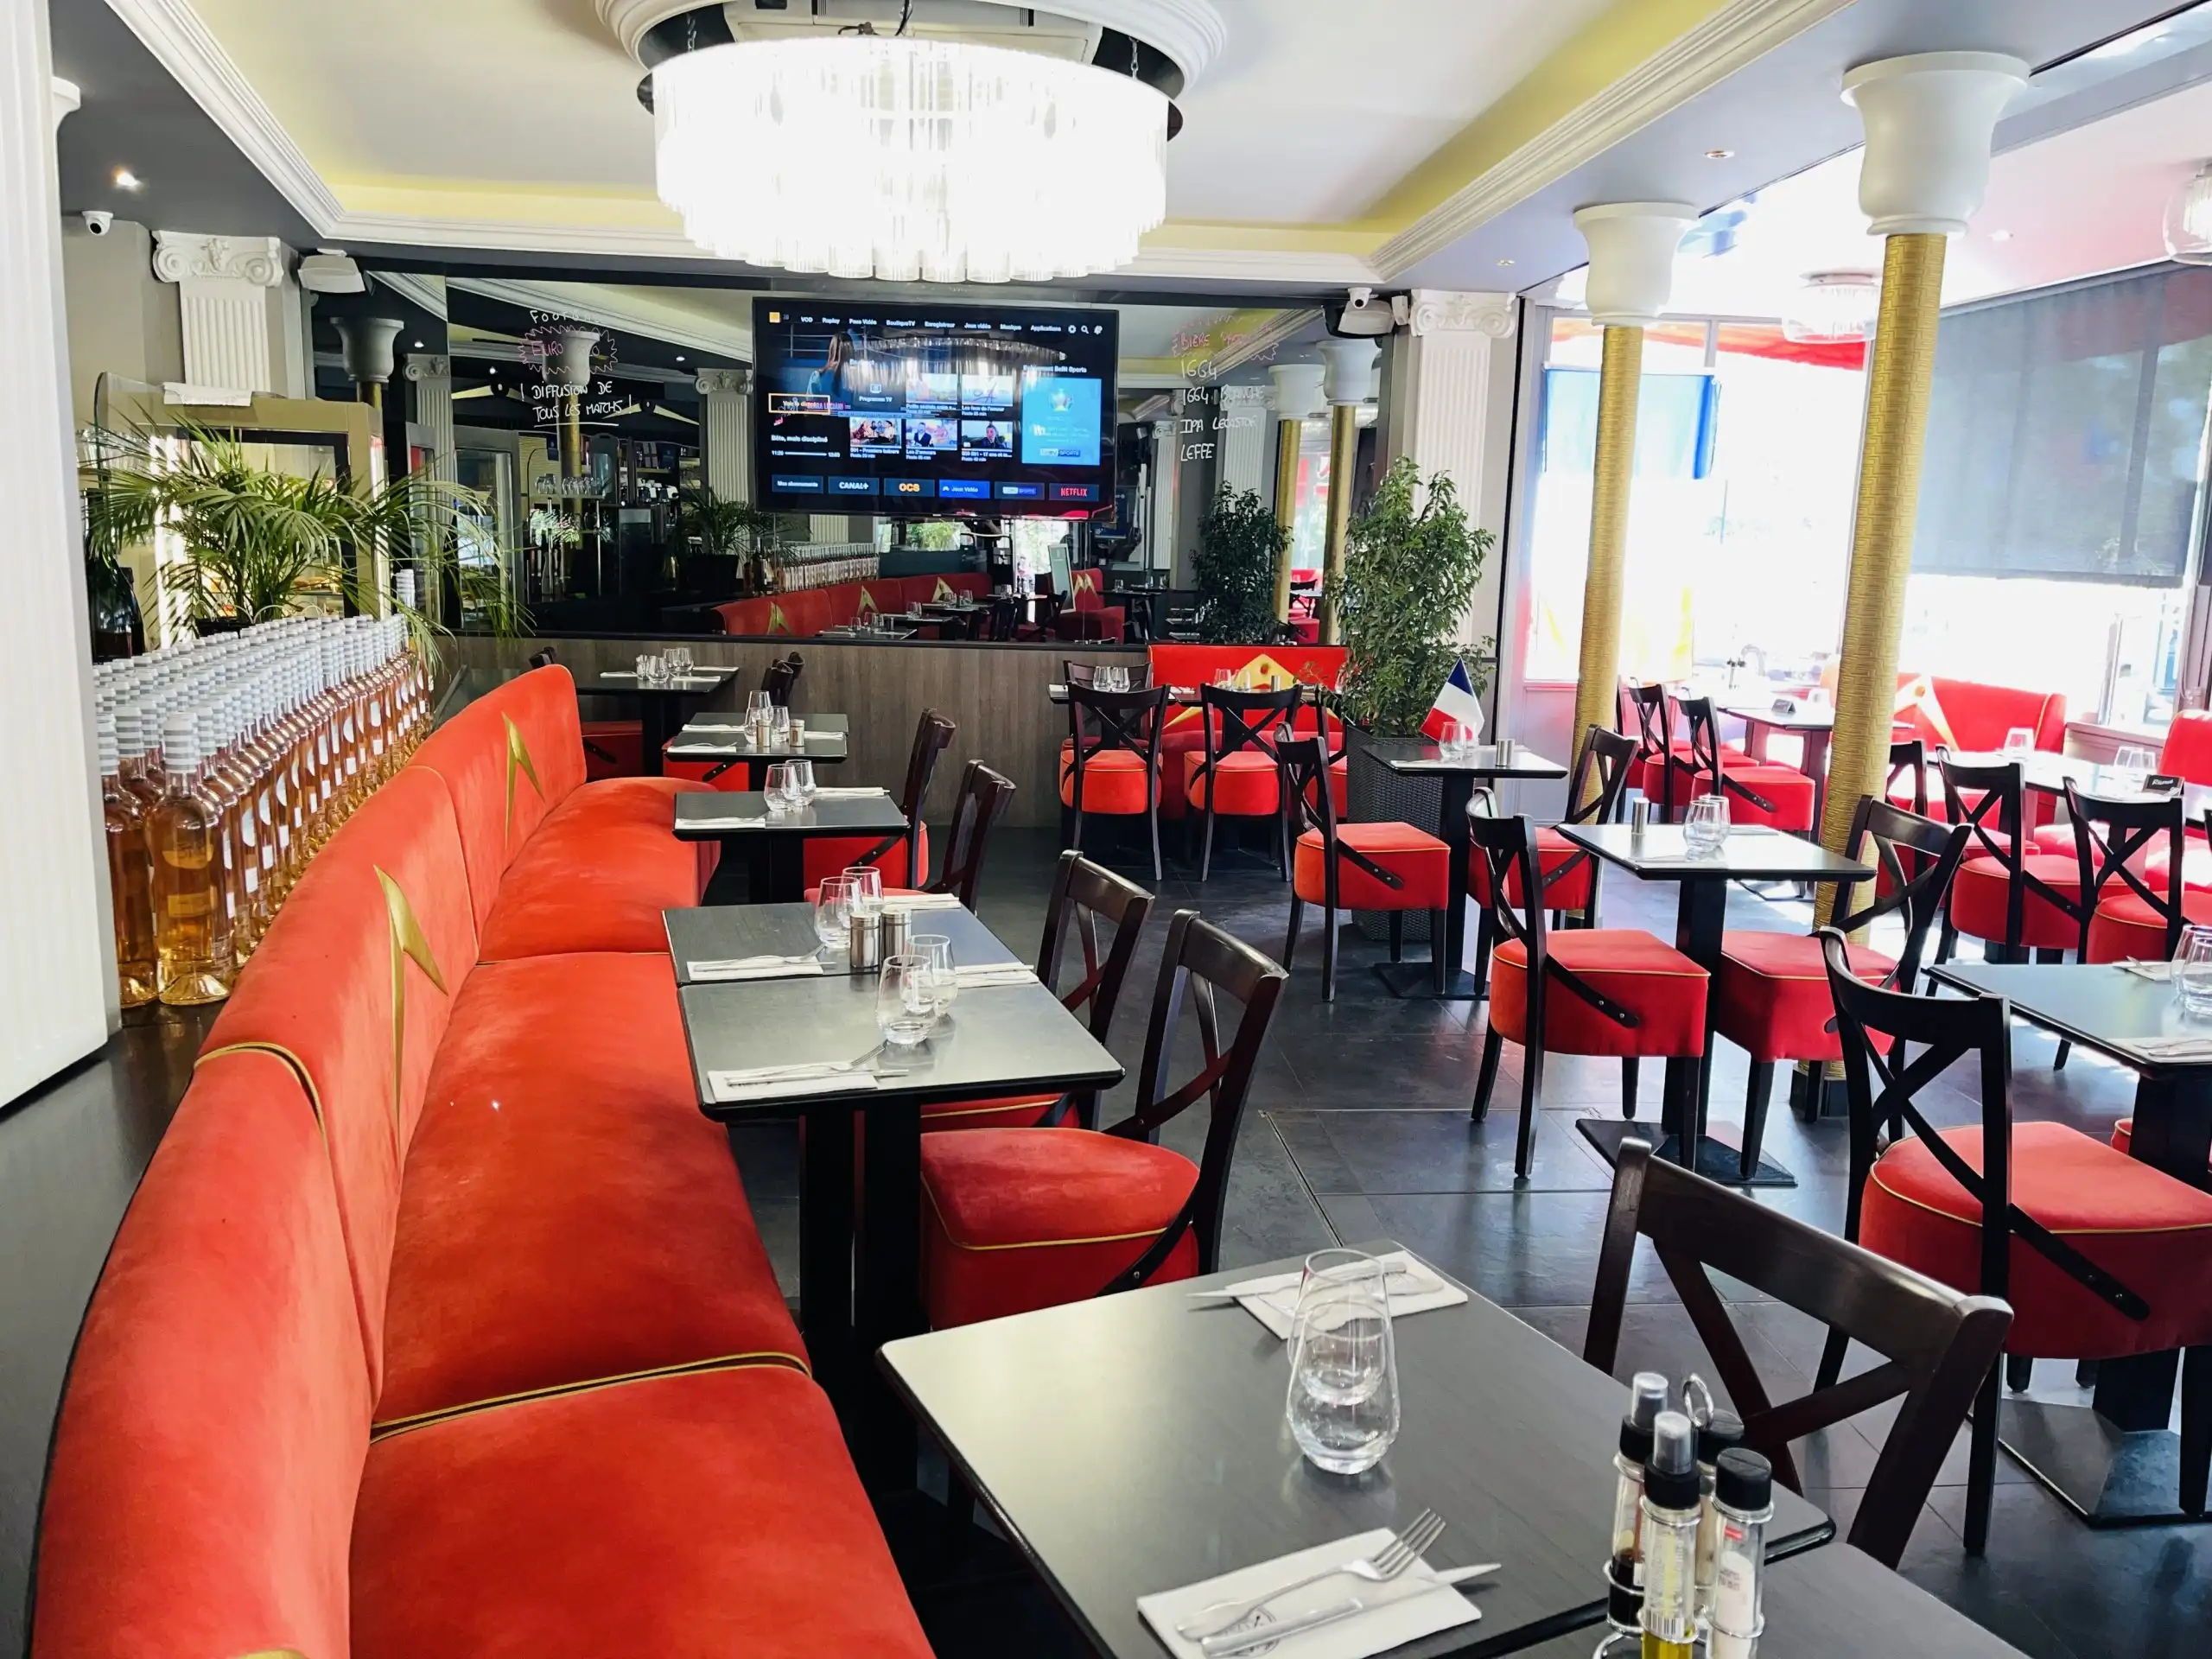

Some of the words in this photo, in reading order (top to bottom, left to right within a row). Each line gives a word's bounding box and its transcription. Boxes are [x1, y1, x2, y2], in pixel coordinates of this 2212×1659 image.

[531, 340, 563, 356] EURO
[1180, 359, 1217, 381] 1664
[597, 381, 613, 395] DE
[1182, 386, 1209, 406] 1664
[532, 404, 559, 423] TOUS
[565, 404, 581, 416] LES
[586, 400, 623, 415] MATCHS
[1179, 419, 1204, 434] IPA
[1180, 443, 1215, 462] LEFFE
[899, 483, 920, 492] OCS
[1060, 487, 1087, 497] NETFLIX
